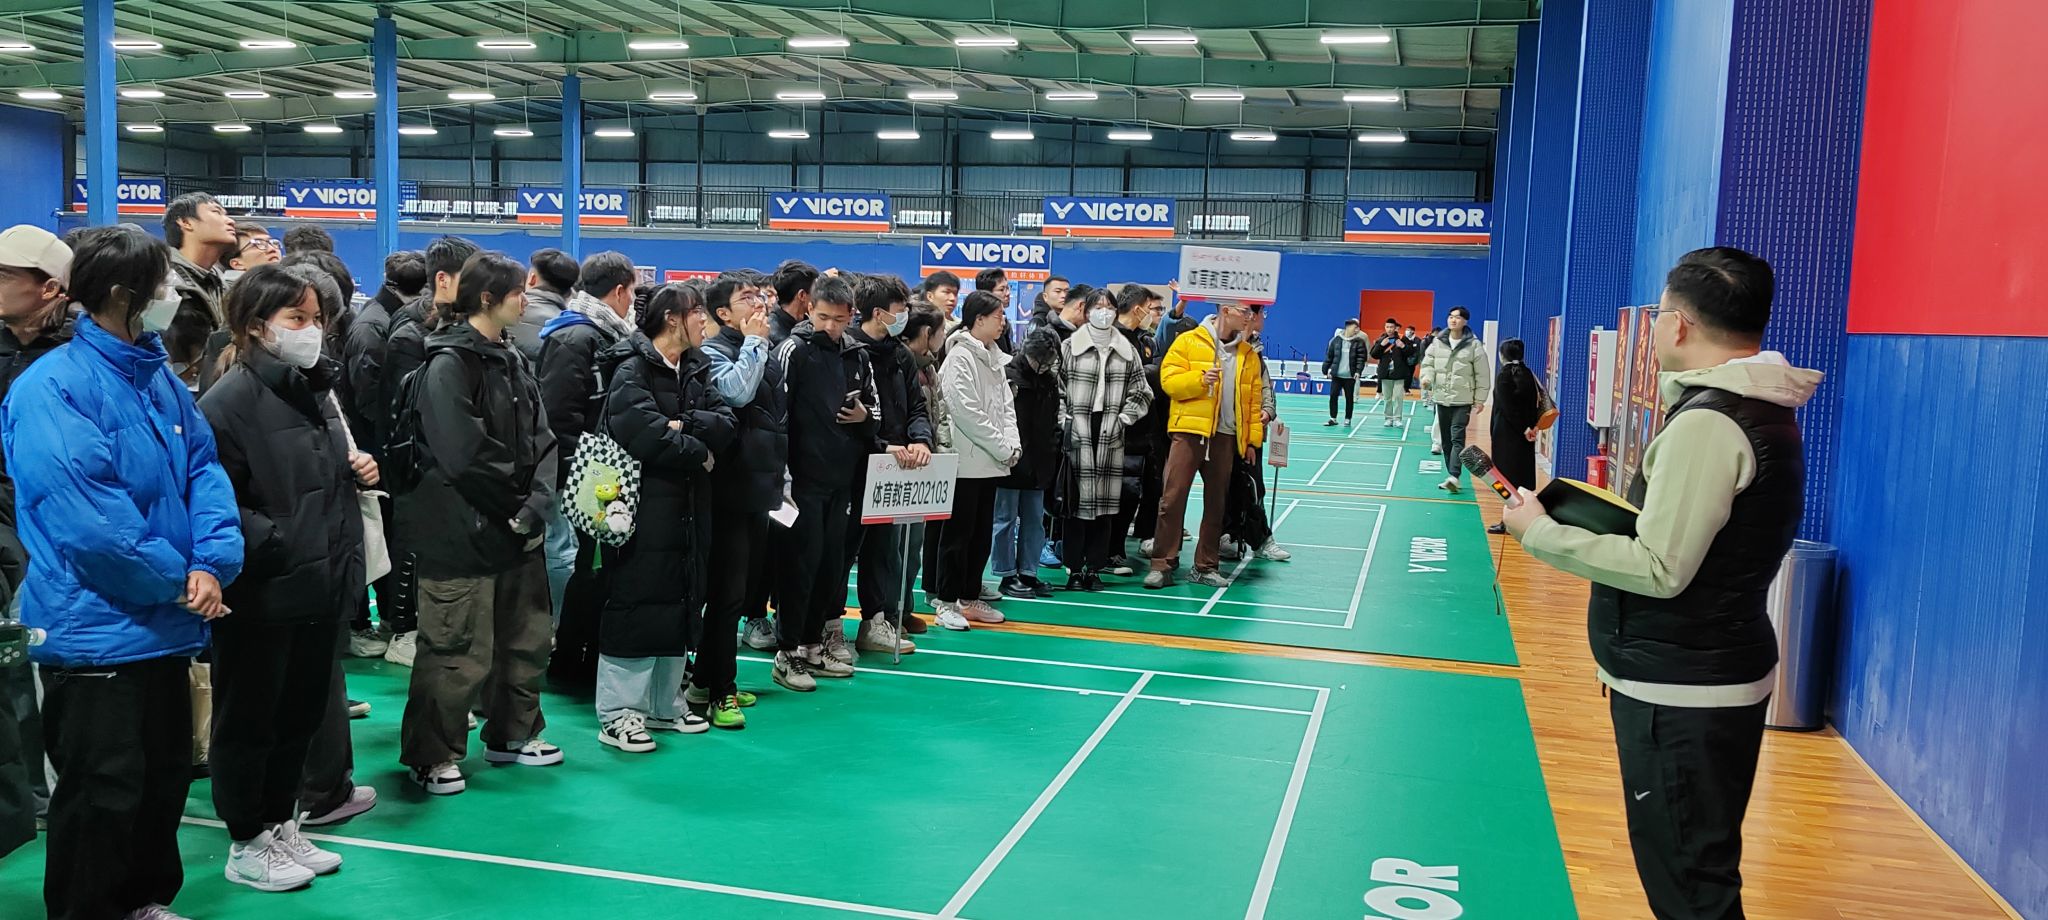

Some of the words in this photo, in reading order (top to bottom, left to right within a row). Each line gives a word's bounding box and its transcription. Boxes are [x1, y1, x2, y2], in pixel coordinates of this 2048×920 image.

[117, 184, 161, 200] CTOR
[802, 198, 885, 217] VICTOR
[1079, 202, 1169, 222] VICTOR
[1385, 207, 1485, 227] VICTOR
[956, 242, 1046, 264] VICTOR
[872, 480, 949, 508] 体育教育202103
[1363, 857, 1463, 920] OR
